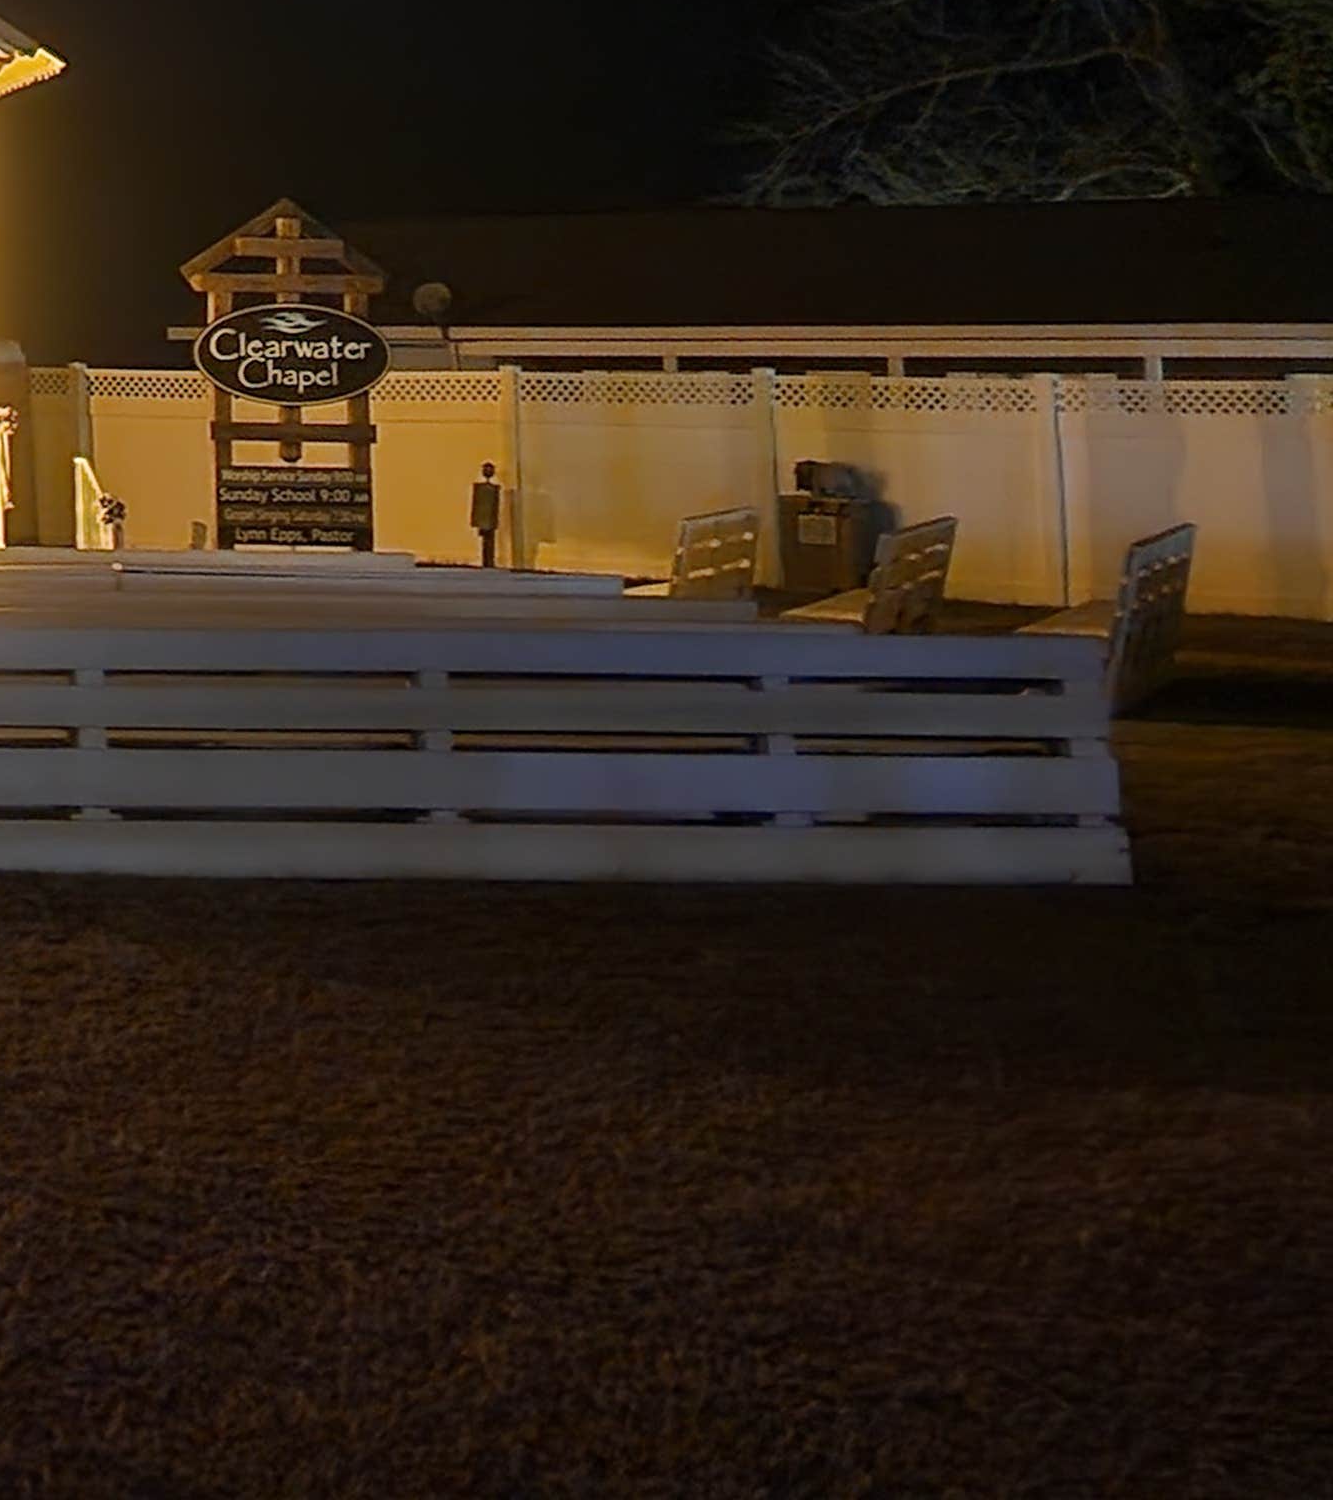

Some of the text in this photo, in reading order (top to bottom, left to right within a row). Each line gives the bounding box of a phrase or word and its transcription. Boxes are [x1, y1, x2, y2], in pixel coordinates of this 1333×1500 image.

[209, 328, 372, 361] Clearwater
[238, 356, 339, 394] Chapel
[219, 487, 269, 504] Sunday
[271, 488, 316, 502] School
[319, 489, 350, 502] 9:00
[236, 527, 267, 542] Lynn
[311, 528, 355, 542] Pastor
